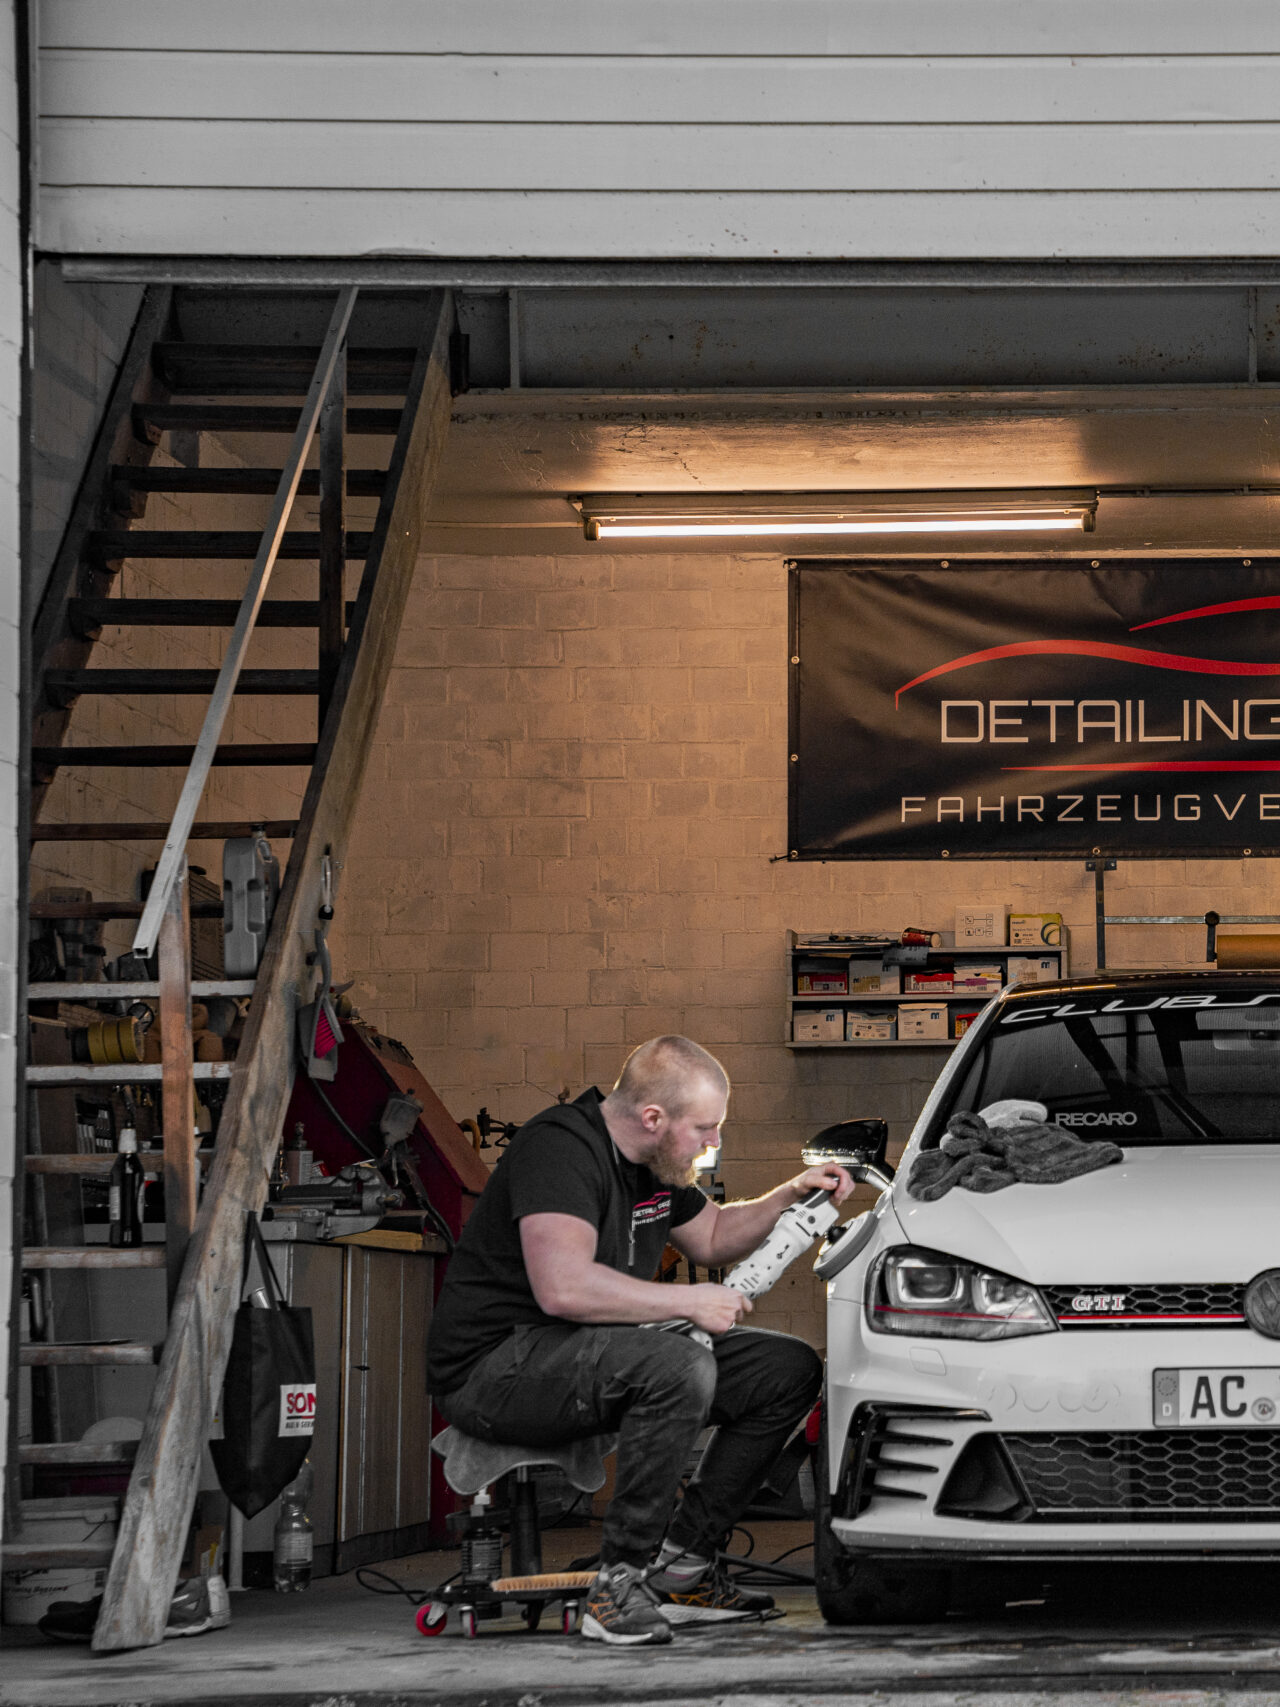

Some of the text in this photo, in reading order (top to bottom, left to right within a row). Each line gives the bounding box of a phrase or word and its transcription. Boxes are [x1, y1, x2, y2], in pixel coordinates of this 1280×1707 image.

[1055, 1111, 1138, 1126] RECARO
[1071, 1294, 1126, 1312] GTI
[1190, 1375, 1247, 1419] AC
